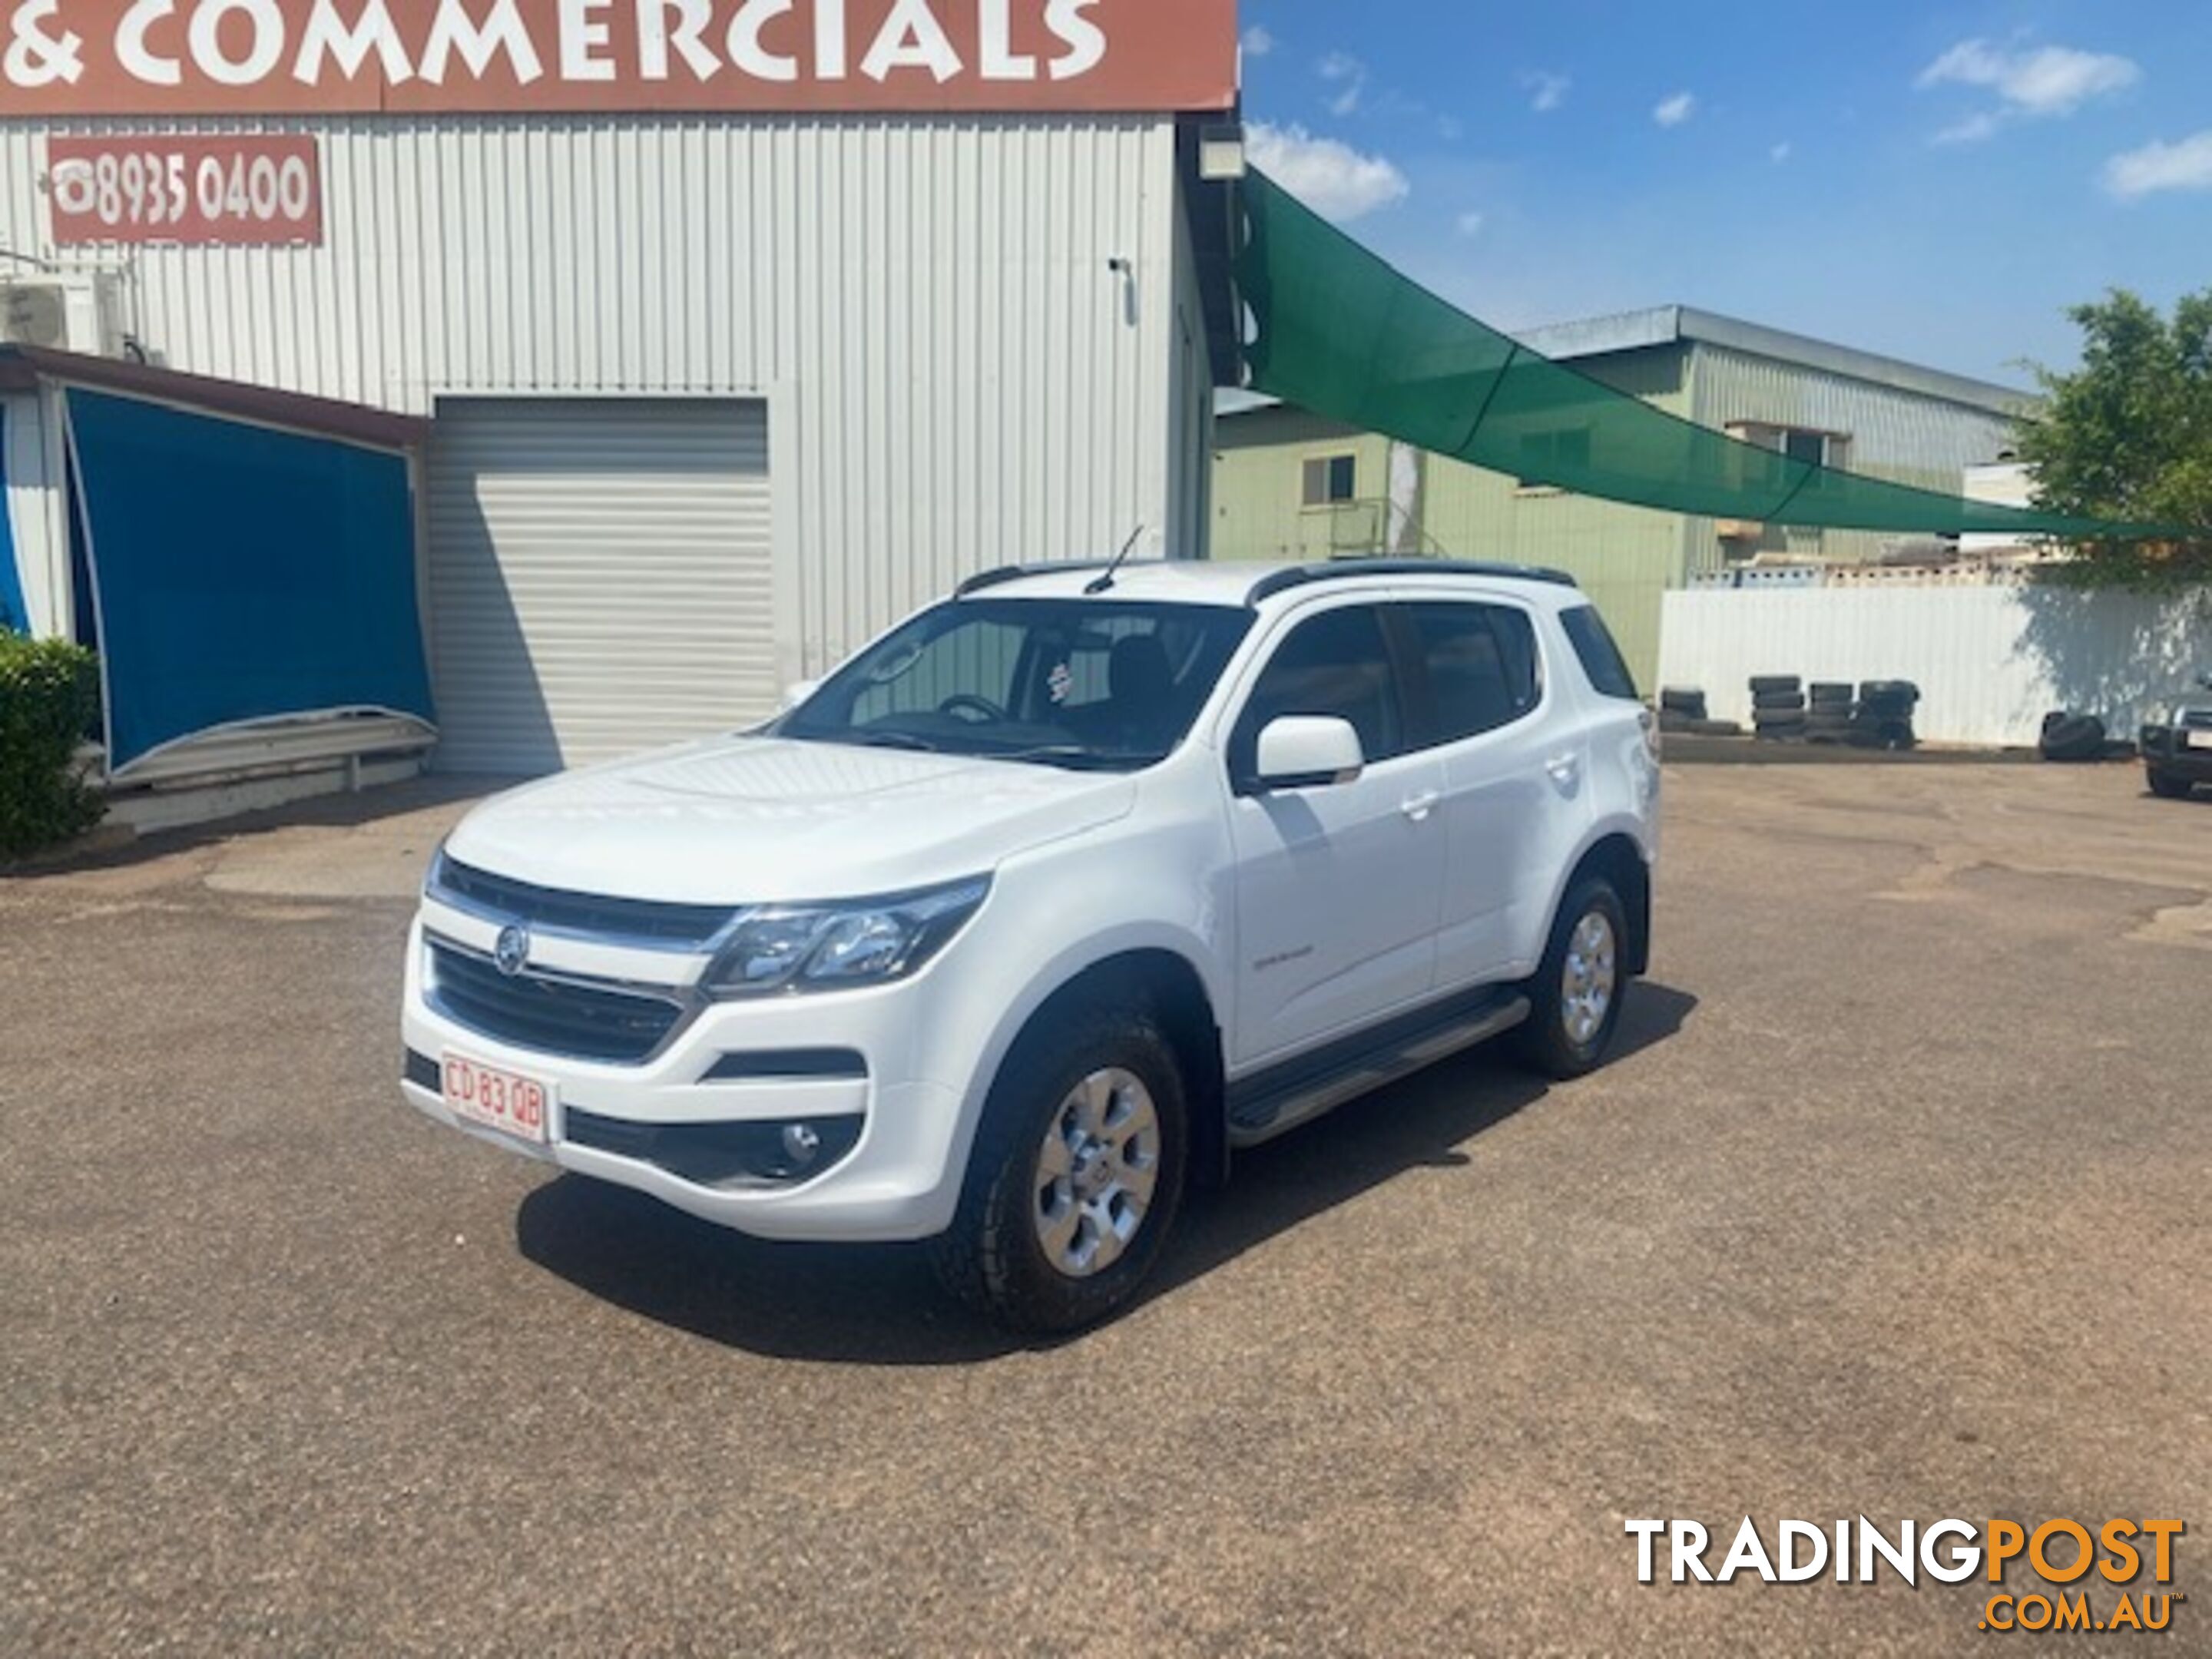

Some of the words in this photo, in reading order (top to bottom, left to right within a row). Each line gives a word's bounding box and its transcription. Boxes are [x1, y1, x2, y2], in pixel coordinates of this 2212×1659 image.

[3, 0, 84, 87] &
[114, 0, 1106, 86] COMMERCIALS
[96, 153, 187, 225] 8935
[196, 153, 309, 220] 0400
